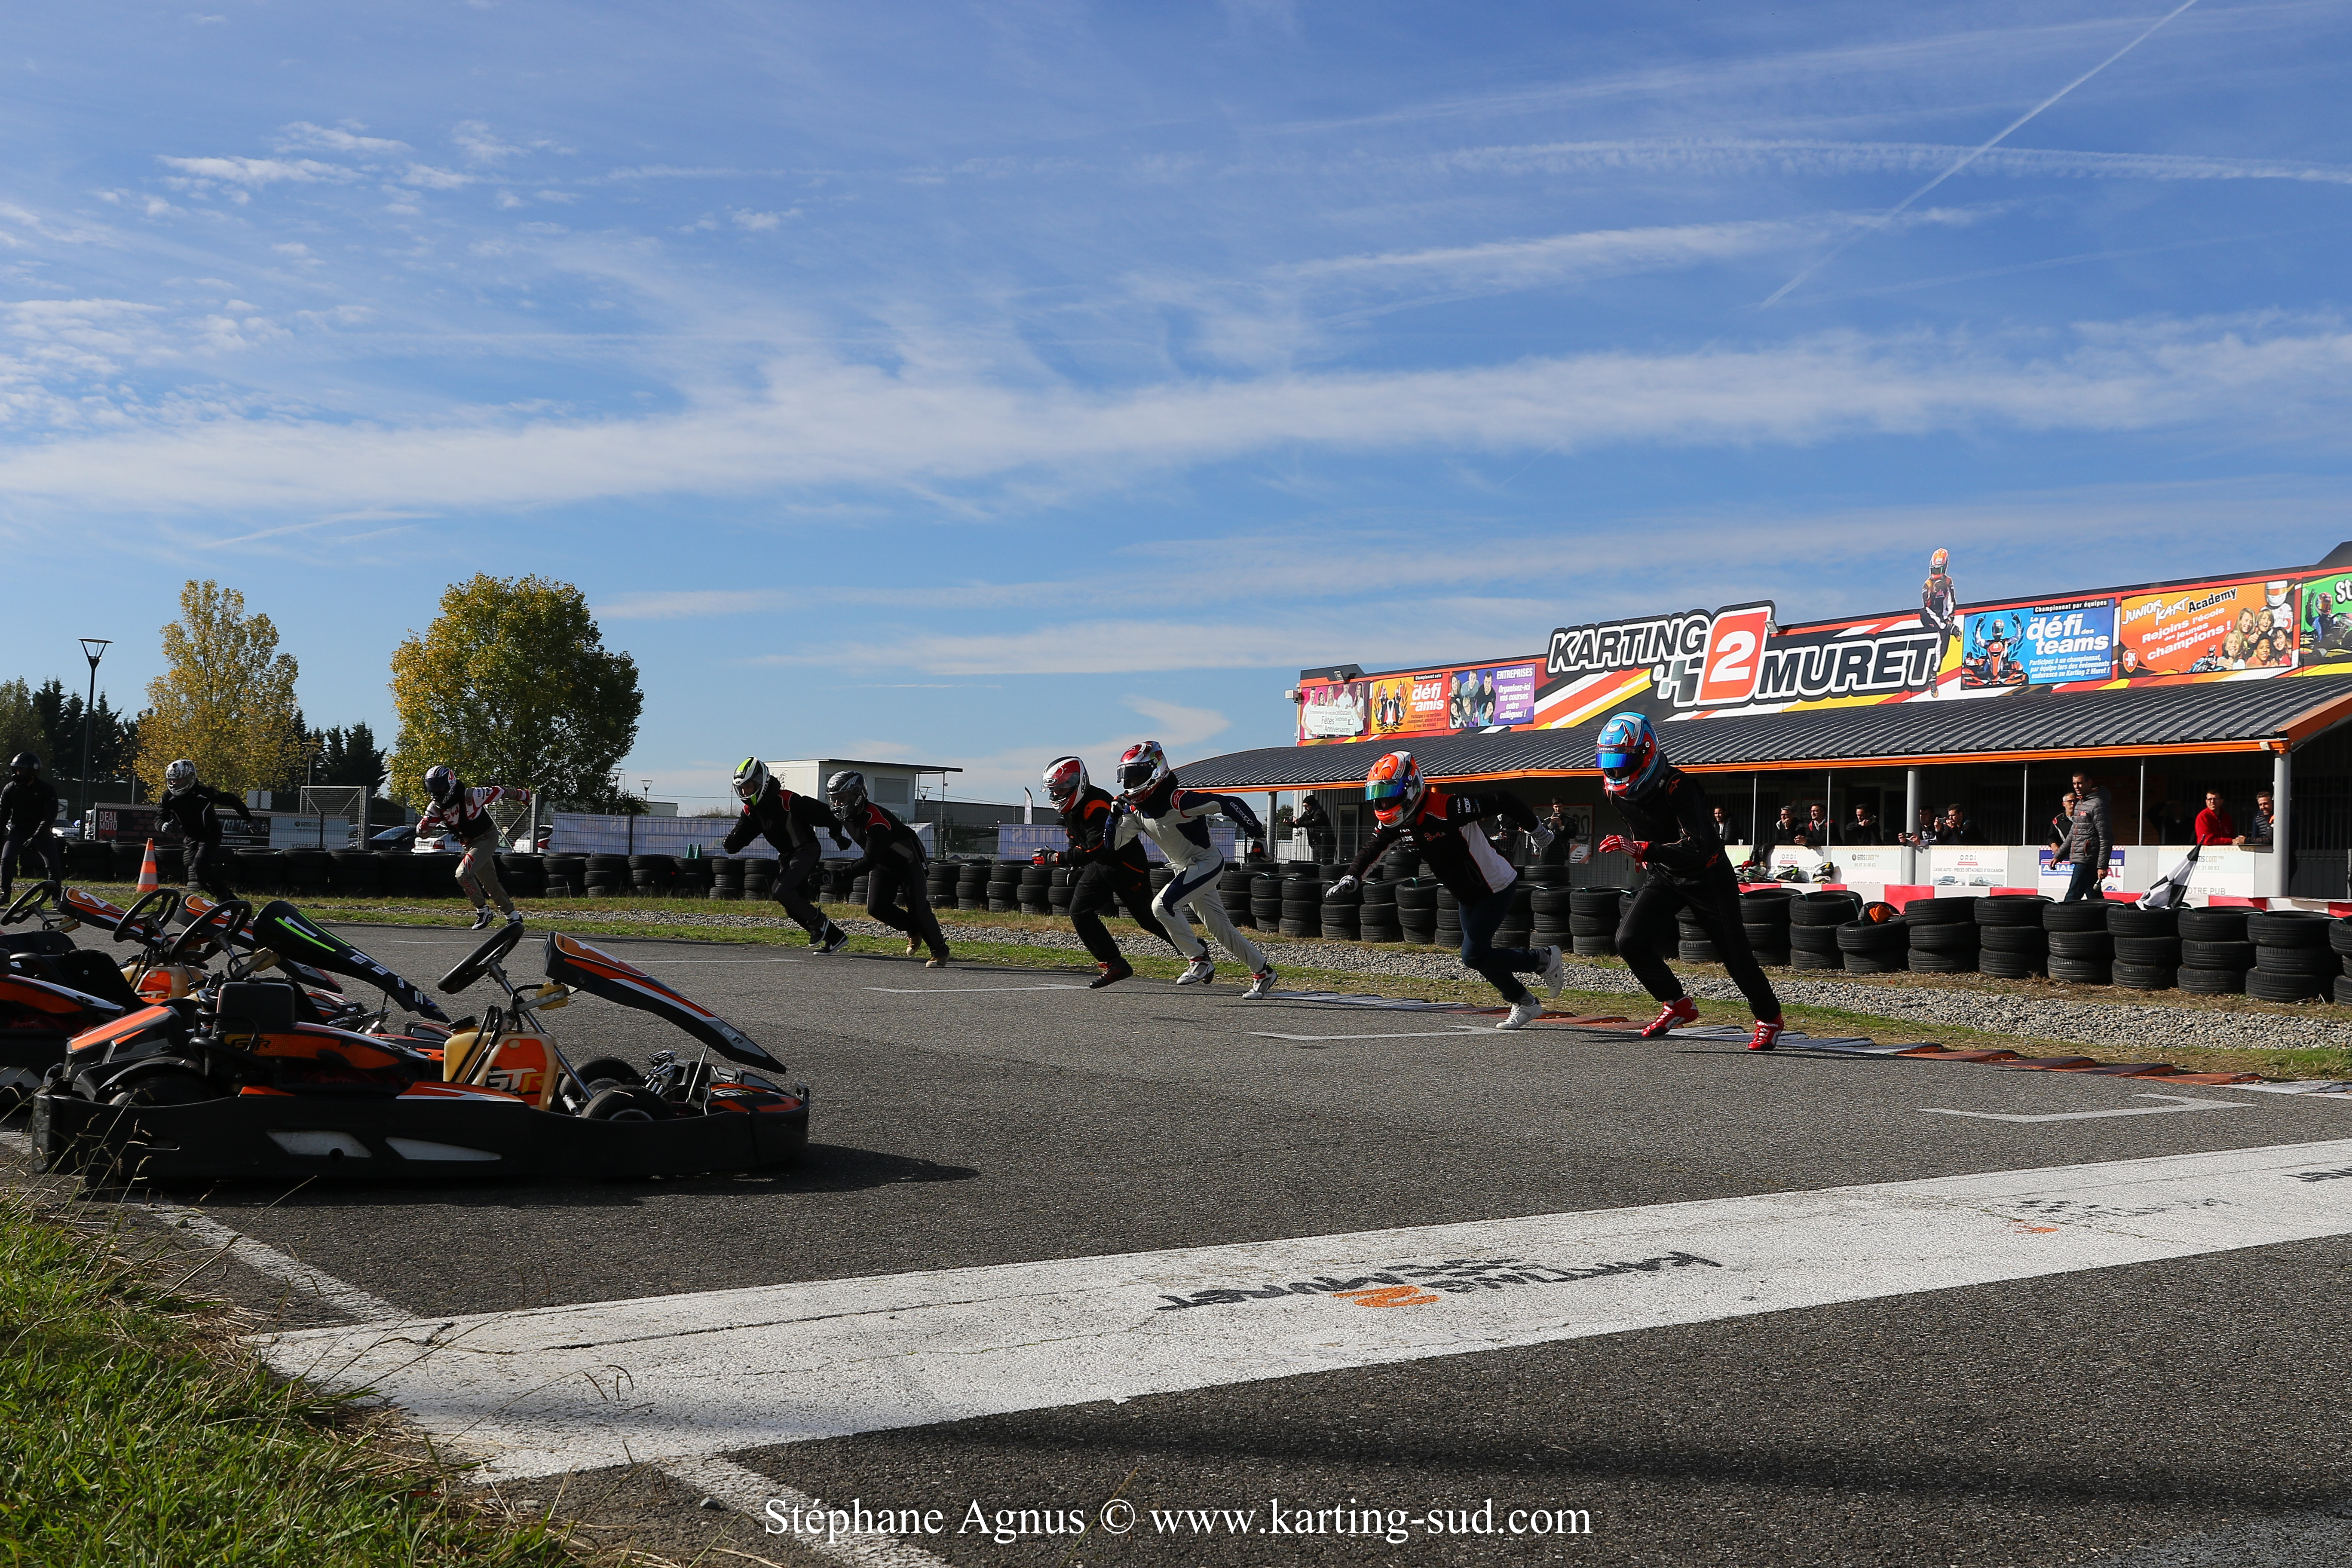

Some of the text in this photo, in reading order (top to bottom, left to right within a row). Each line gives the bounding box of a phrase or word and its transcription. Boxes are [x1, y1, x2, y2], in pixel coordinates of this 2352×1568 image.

[2335, 579, 2352, 603] St
[2035, 600, 2107, 613] Championnat par équipes
[2122, 588, 2236, 626] JUNIOR KART Academy
[2027, 613, 2084, 640] défi
[2142, 607, 2225, 643] Rejoins l'école
[2176, 622, 2209, 640] jeunes
[2036, 635, 2109, 655] teams
[2147, 620, 2231, 660] champions !
[1550, 619, 1938, 693] KARTING 2 MURET
[2029, 658, 2054, 668] Participez
[2040, 664, 2057, 673] équipe
[2079, 659, 2110, 669] événements
[2066, 668, 2085, 677] Karting
[1497, 667, 1533, 680] ENTREPRISES
[1412, 682, 1442, 701] défi
[1498, 683, 1531, 694] Organisez-ici
[1509, 693, 1529, 701] courses
[1415, 697, 1445, 712] amis
[1506, 701, 1519, 710] entre
[1524, 709, 1527, 717] !
[1322, 716, 1335, 725] Fêtes
[99, 811, 117, 822] DEAL
[99, 822, 117, 830] MOTO
[79, 891, 108, 909] 2
